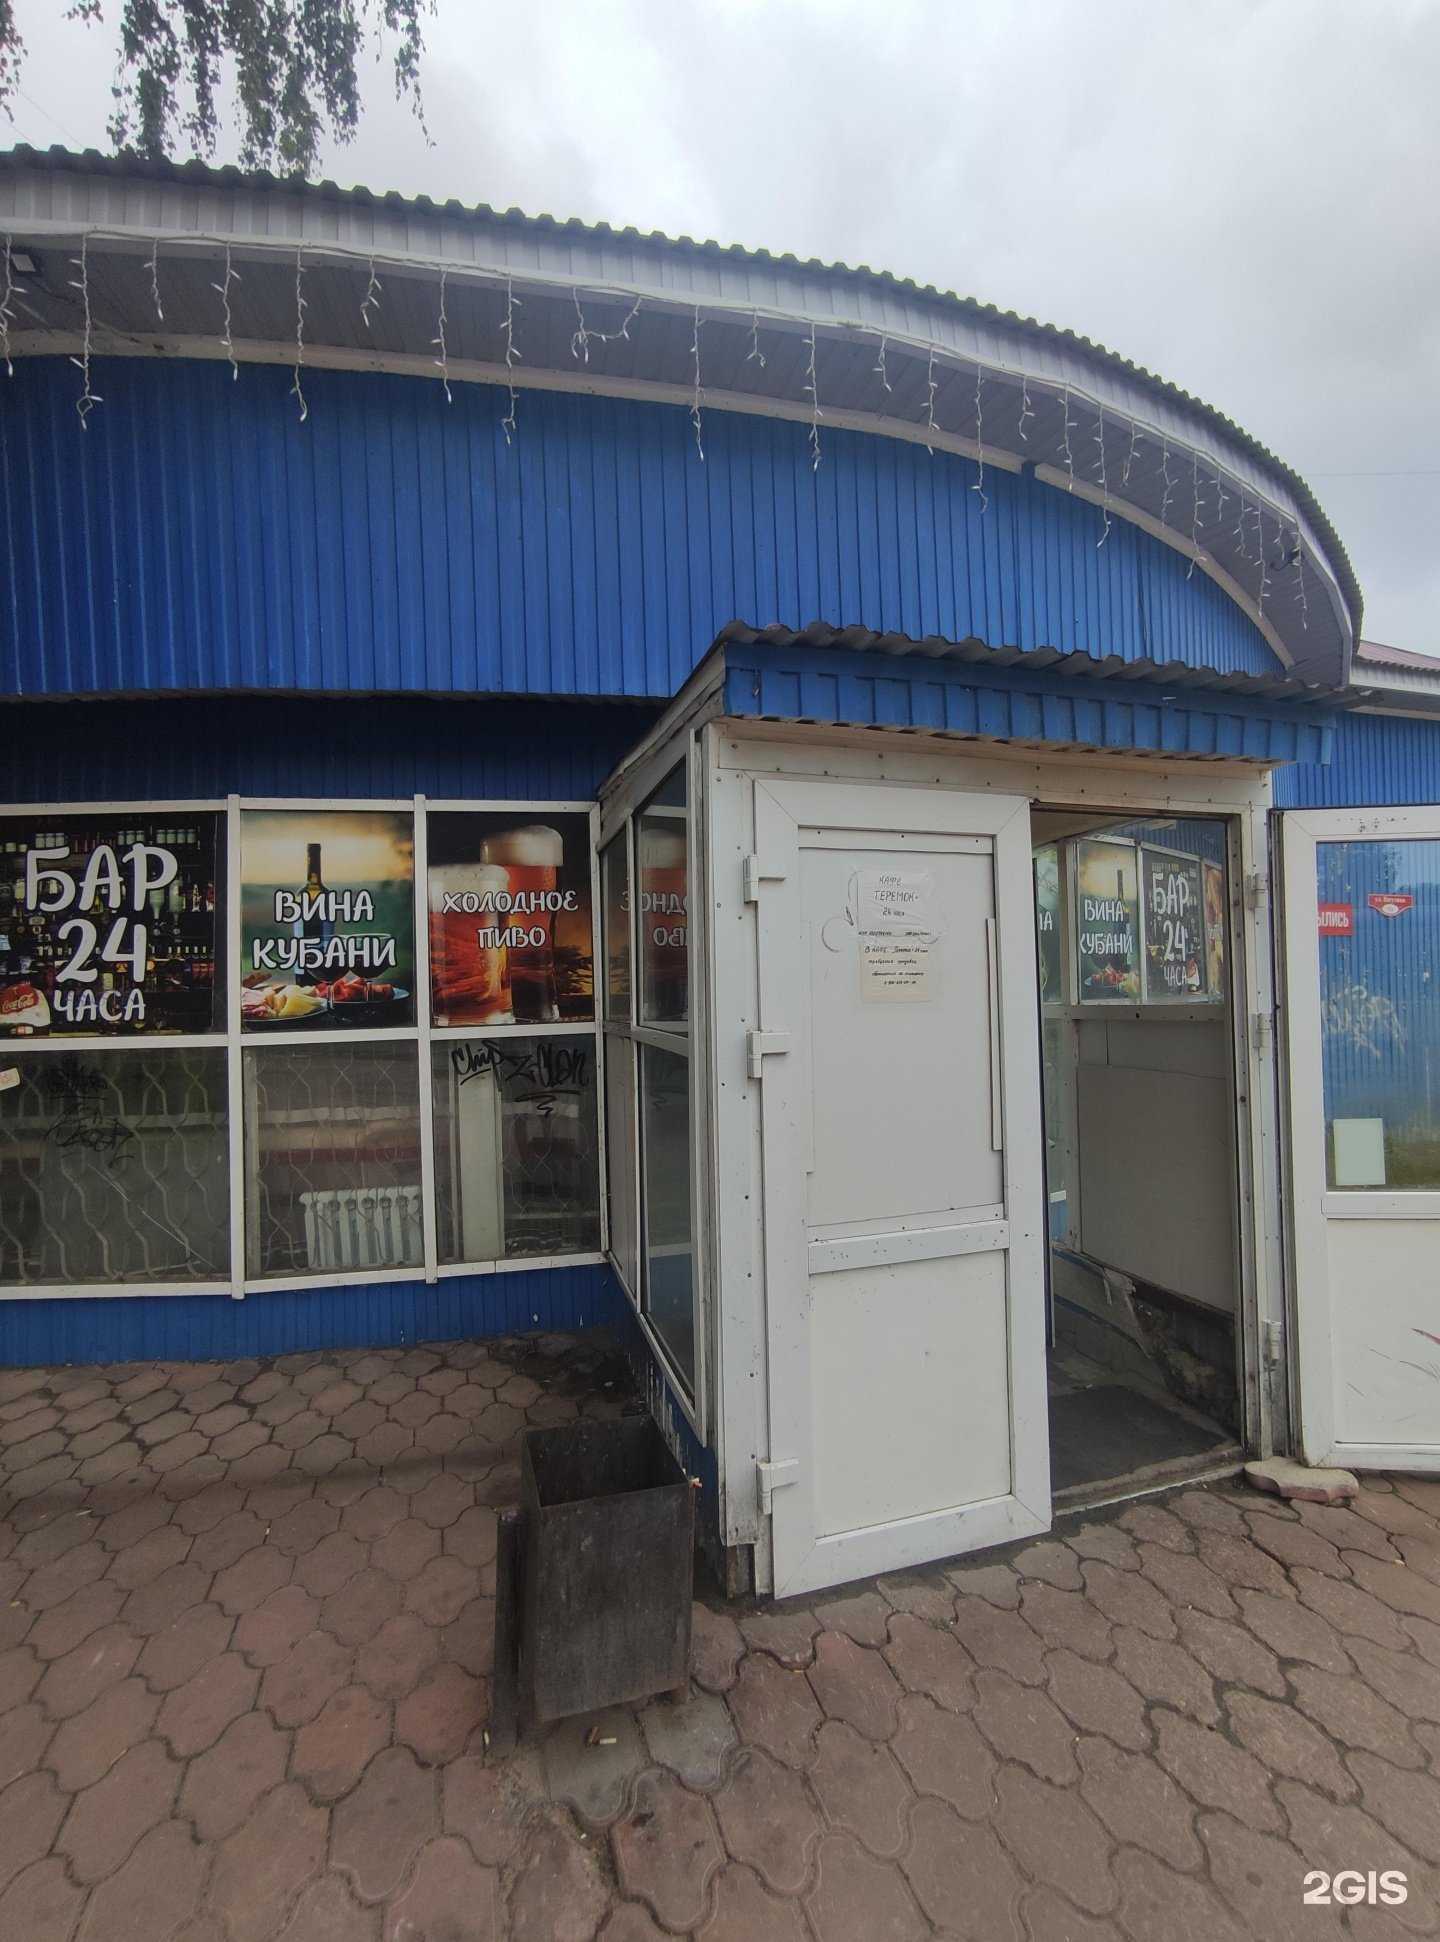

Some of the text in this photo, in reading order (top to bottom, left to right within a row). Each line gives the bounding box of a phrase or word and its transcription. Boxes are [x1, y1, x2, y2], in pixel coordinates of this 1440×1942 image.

[25, 843, 179, 912] БАР
[1152, 872, 1190, 917] БАР
[273, 890, 374, 922] ВИНА
[443, 890, 579, 915] ХОЛОДНОЕ
[1084, 899, 1124, 922] ВИНА
[55, 918, 146, 983] 24
[252, 936, 397, 970] КУБАНИ
[478, 926, 546, 949] ПИВО
[1163, 920, 1188, 962] 24
[1164, 966, 1188, 986] ЧАСА
[53, 988, 146, 1022] ЧАСА
